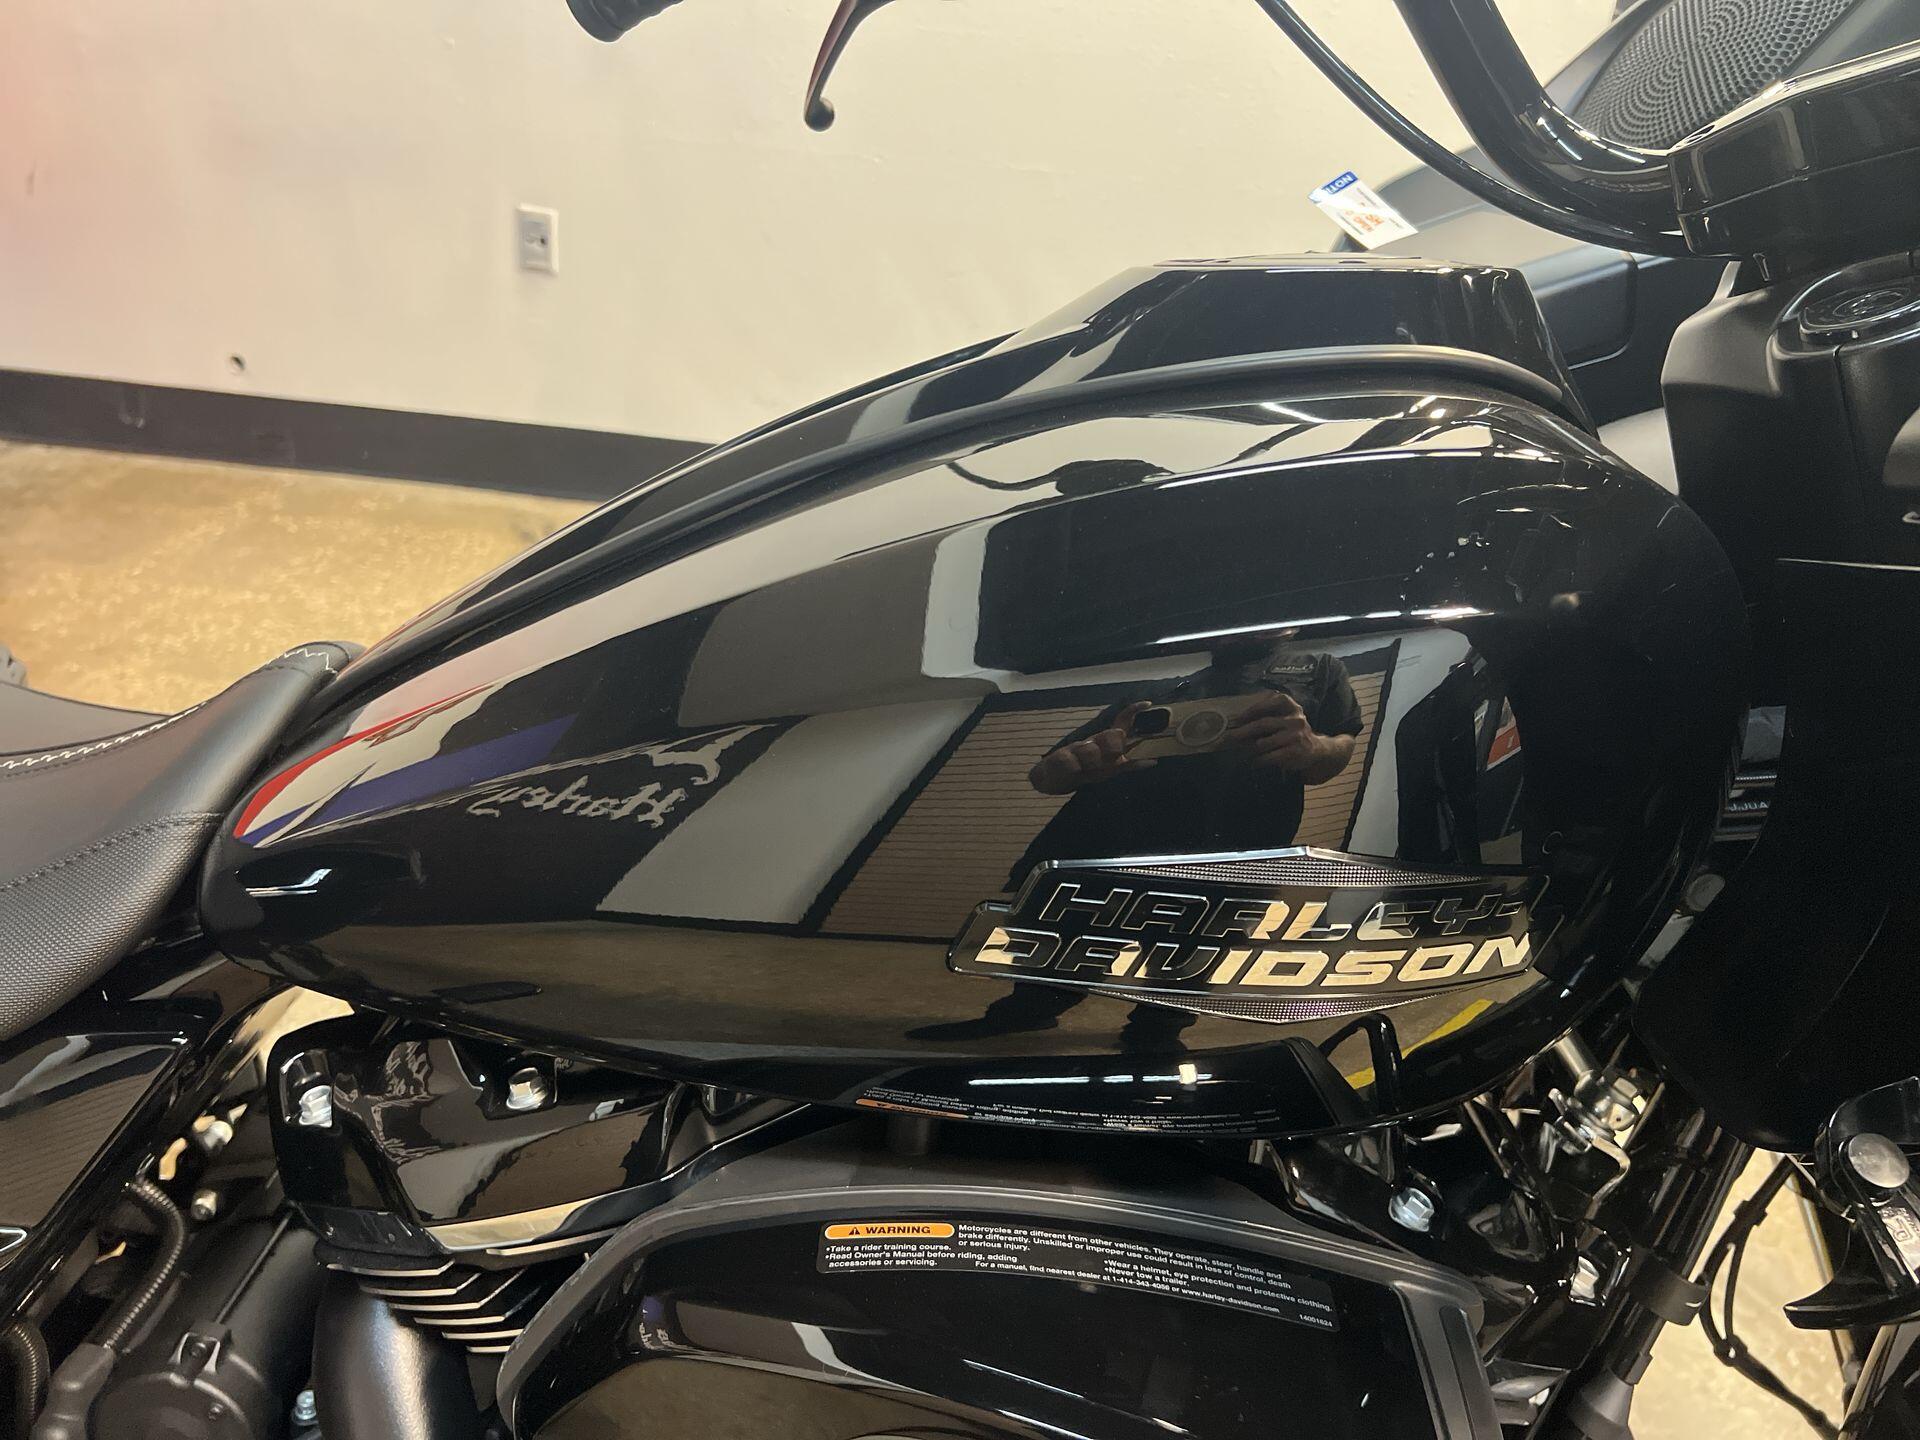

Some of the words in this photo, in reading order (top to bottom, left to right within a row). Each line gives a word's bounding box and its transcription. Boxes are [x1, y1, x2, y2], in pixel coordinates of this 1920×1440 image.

[975, 926, 1531, 987] DAVIDSON
[865, 1226, 931, 1234] WARNING
[958, 1224, 1012, 1234] Motorcycles
[1029, 1230, 1066, 1240] different
[1067, 1234, 1088, 1243] from
[1089, 1238, 1113, 1246] other
[1114, 1242, 1151, 1253] vehicles.
[1153, 1247, 1174, 1258] They
[1175, 1252, 1210, 1265] operate,
[1211, 1259, 1235, 1270] steer,
[1236, 1264, 1265, 1276] handle
[1266, 1271, 1282, 1280] and
[1003, 1242, 1031, 1251] injury.
[828, 1259, 882, 1268] accessories
[895, 1258, 938, 1267] servicing.
[957, 1252, 985, 1261] riding,
[987, 1253, 1018, 1263] adding
[984, 1233, 1031, 1244] differently.
[1032, 1237, 1073, 1248] Unskilled
[1085, 1244, 1125, 1256] improper
[1143, 1254, 1168, 1263] could
[1169, 1259, 1194, 1268] result
[1204, 1265, 1222, 1274] loss
[1267, 1279, 1292, 1290] death
[975, 1260, 989, 1268] For
[996, 1263, 1028, 1272] manual,
[1046, 1268, 1076, 1277] nearest
[1076, 1271, 1101, 1280] dealer
[1136, 1271, 1152, 1280] tow
[1161, 1275, 1190, 1287] trailer.
[1140, 1264, 1172, 1277] helmet,
[1173, 1271, 1189, 1280] eye
[1190, 1274, 1235, 1289] protection
[1236, 1284, 1252, 1292] and
[1253, 1287, 1296, 1302] protective
[1297, 1298, 1333, 1313] clothing.
